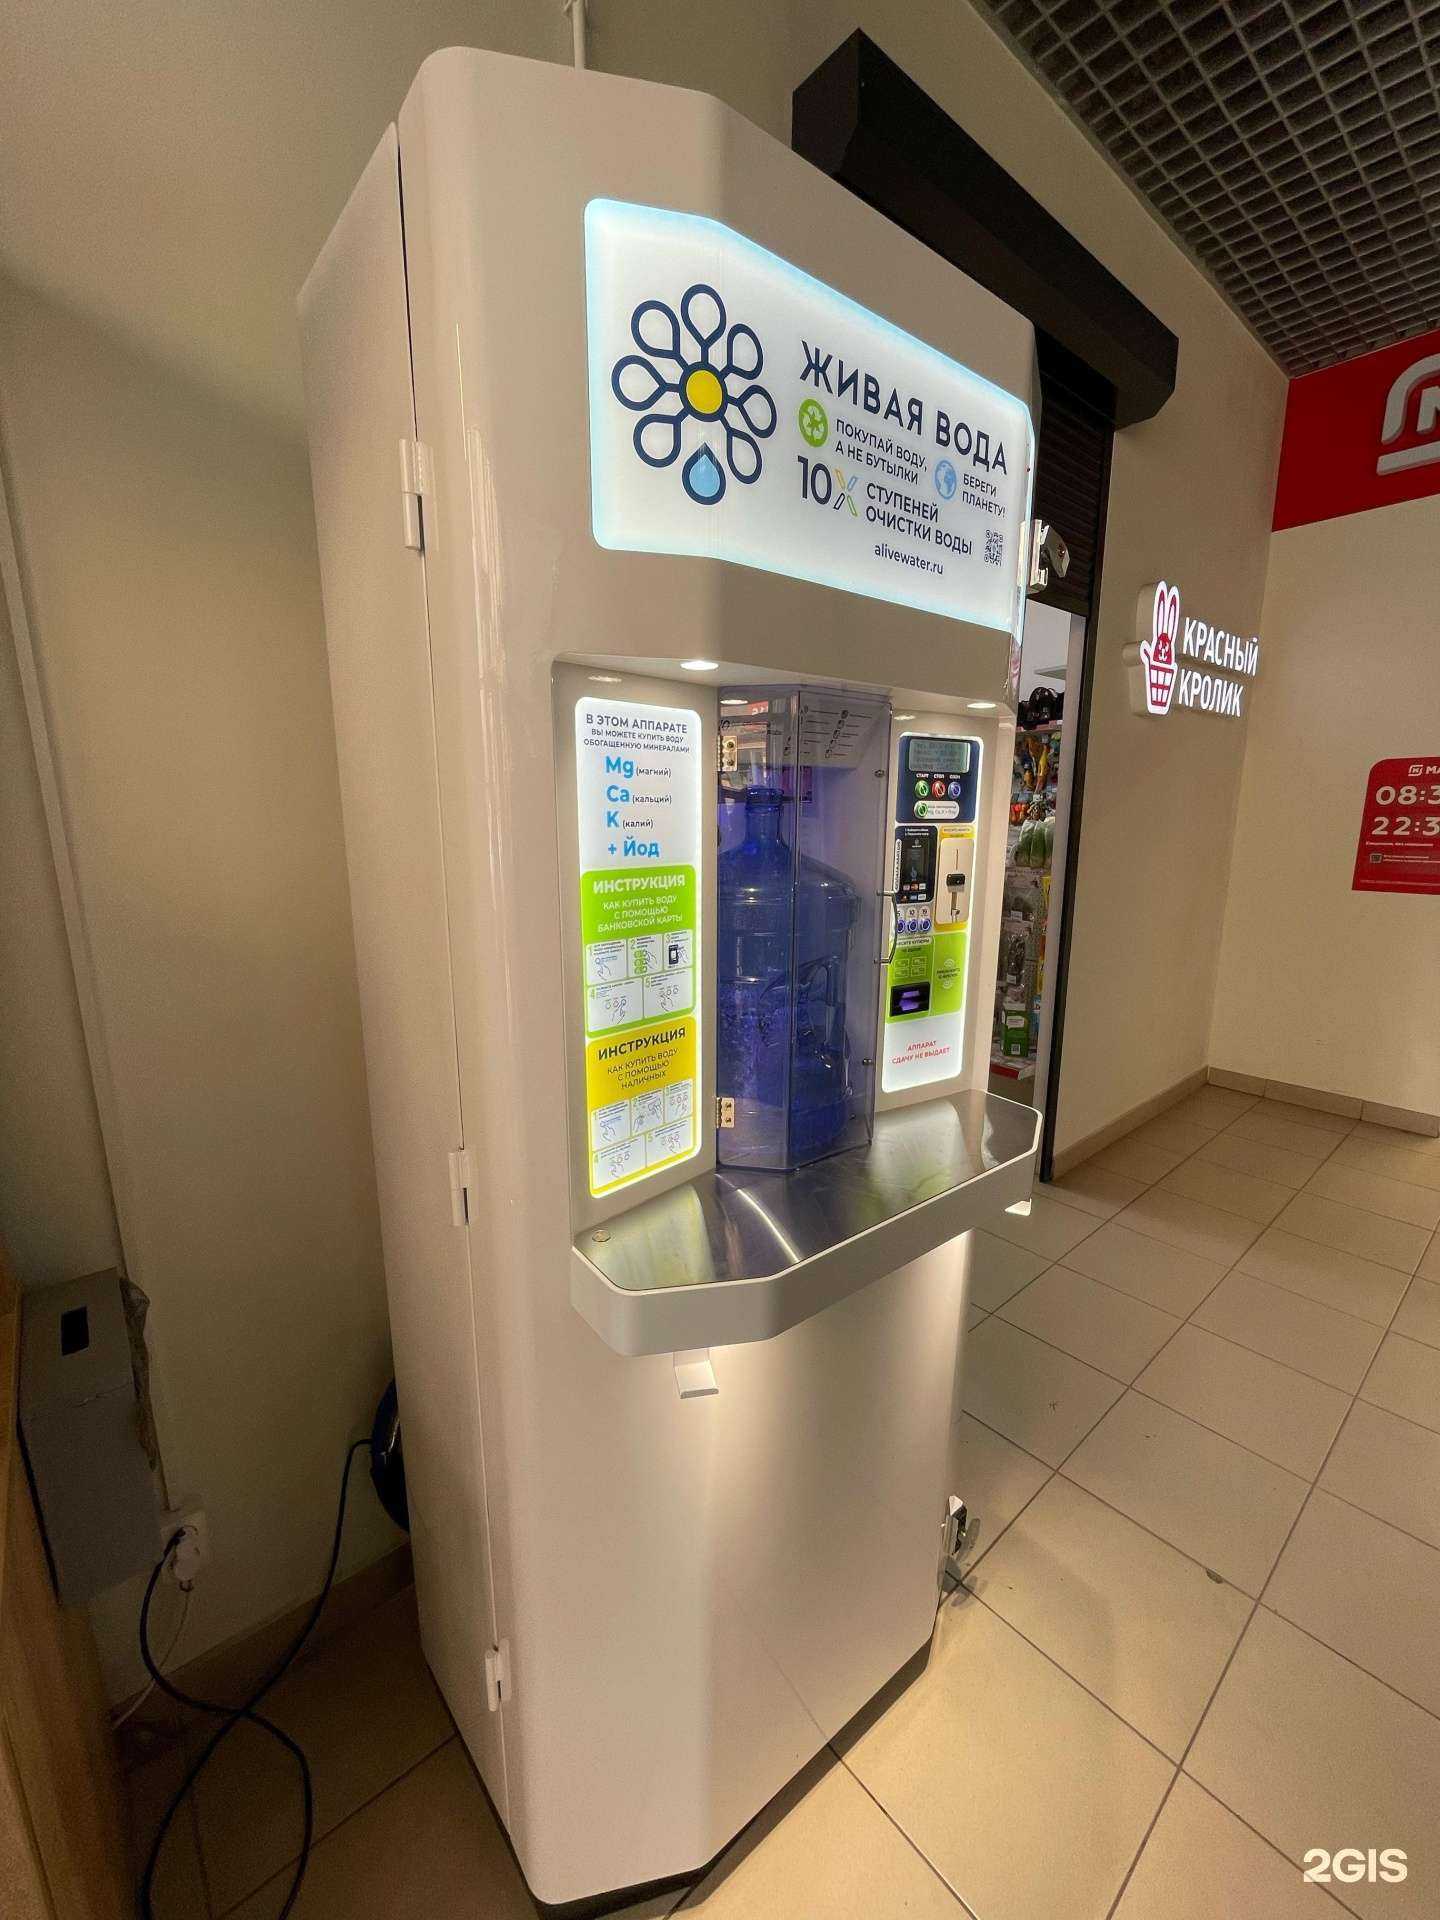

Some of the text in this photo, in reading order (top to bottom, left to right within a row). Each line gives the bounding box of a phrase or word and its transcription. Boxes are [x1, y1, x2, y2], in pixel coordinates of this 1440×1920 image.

[800, 340, 1007, 475] ЖИВАЯ ВОДА
[836, 418, 927, 472] ПОКУПАЙ ВОДУ,
[835, 440, 918, 485] А НЕ БУТЫЛКИ
[797, 455, 832, 505] 10
[963, 473, 997, 498] БЕРЕГИ
[866, 482, 939, 523] СТУПЕНЕЙ
[962, 490, 1006, 519] ПЛАНЕТУ!
[866, 505, 972, 555] ОЧИСТКИ ВОДЫ
[874, 543, 943, 575] alivewater.ru
[1183, 617, 1260, 676] КРАСНЫЙ
[1178, 669, 1244, 717] КРОЛИК
[586, 713, 688, 734] В ЭТОМ АППАРАТЕ
[591, 728, 684, 743] ВЫ МОЖЕТЕ КУПИТЬ ВОДУ
[643, 743, 690, 753] МИНЕРАЛАМИ
[605, 755, 672, 779] Mg (магний)
[606, 784, 630, 803] Ca
[606, 810, 654, 829] K (калий)
[608, 836, 660, 858] + Йод
[593, 874, 686, 894] ИНСТРУКЦИЯ
[603, 895, 678, 911] КАК КУПИТЬ ВОДУ
[622, 905, 669, 919] ПОМОЩЬЮ
[598, 912, 683, 933] БАНКОВСКОЙ КАРТЫ
[598, 1027, 686, 1061] ИНСТРУКЦИЯ
[907, 1040, 937, 1052] АППАРАТ
[608, 1047, 679, 1075] КАК КУПИТЬ ВОДУ
[625, 1060, 670, 1078] ПОМОЩЬЮ
[891, 1055, 913, 1065] СДАЧУ
[621, 1070, 666, 1089] НАЛИЧНЫХ
